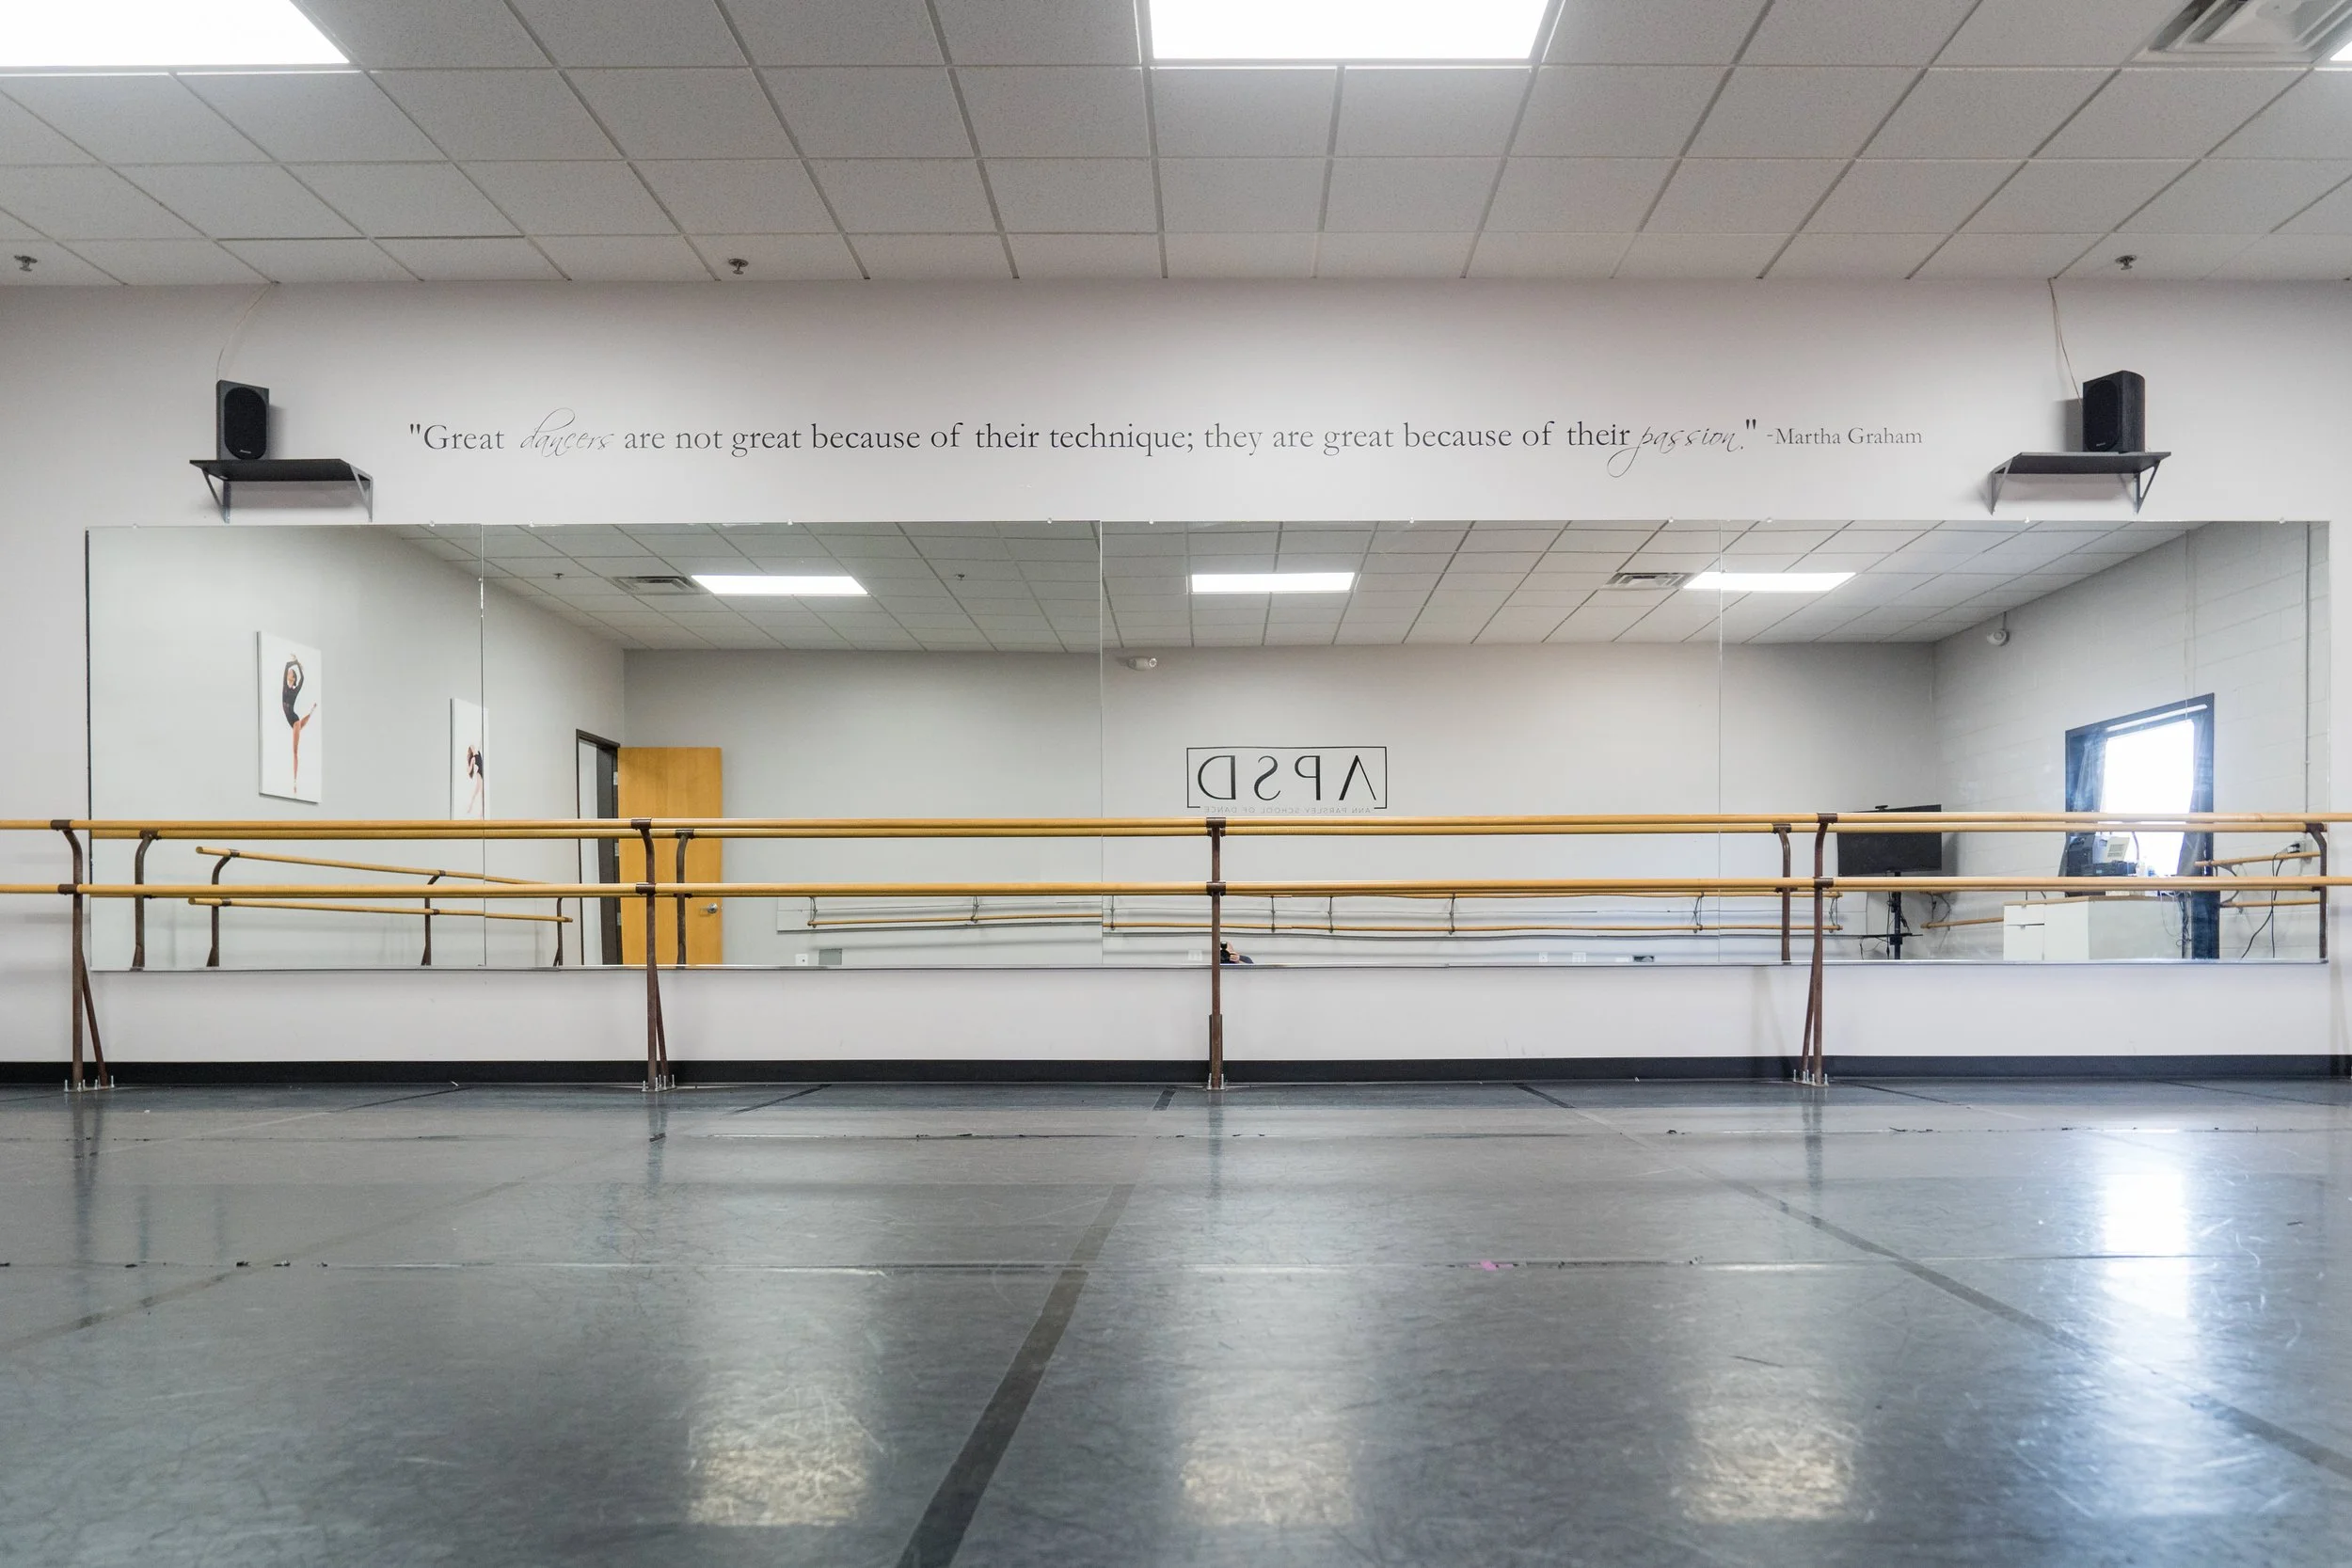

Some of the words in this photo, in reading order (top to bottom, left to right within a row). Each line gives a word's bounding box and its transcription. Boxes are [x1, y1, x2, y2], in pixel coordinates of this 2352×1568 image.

[409, 421, 504, 451] "Great
[519, 407, 614, 458] dancers
[625, 431, 665, 451] are
[675, 429, 723, 451] not
[730, 428, 803, 458] great
[811, 421, 921, 451] because
[930, 421, 964, 451] of
[975, 421, 1041, 451] their
[1049, 421, 1196, 458] technique;
[1203, 422, 1263, 457] they
[1272, 429, 1314, 450] are
[1323, 428, 1396, 458] great
[1403, 421, 1513, 450] because
[1520, 420, 1557, 449] of
[1565, 420, 1631, 449] their
[1766, 423, 1842, 445] -Martha
[1847, 425, 1923, 445] Graham
